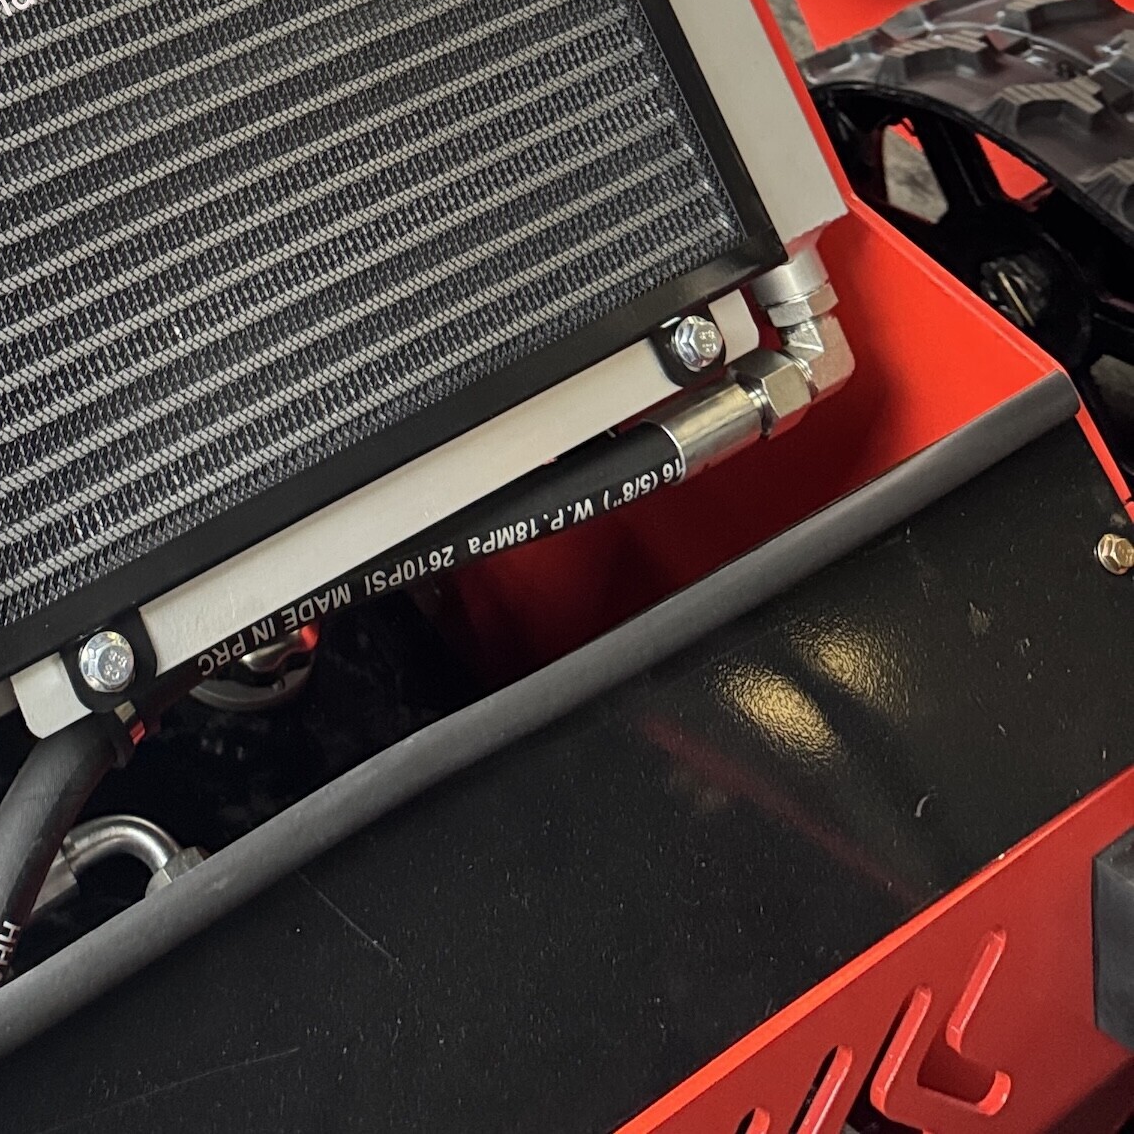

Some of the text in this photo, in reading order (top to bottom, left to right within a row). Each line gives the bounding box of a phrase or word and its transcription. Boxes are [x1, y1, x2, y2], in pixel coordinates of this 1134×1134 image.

[364, 545, 455, 596] 2610PSI
[281, 583, 352, 631] MADE
[252, 617, 276, 646] IN
[197, 633, 247, 676] PRC
